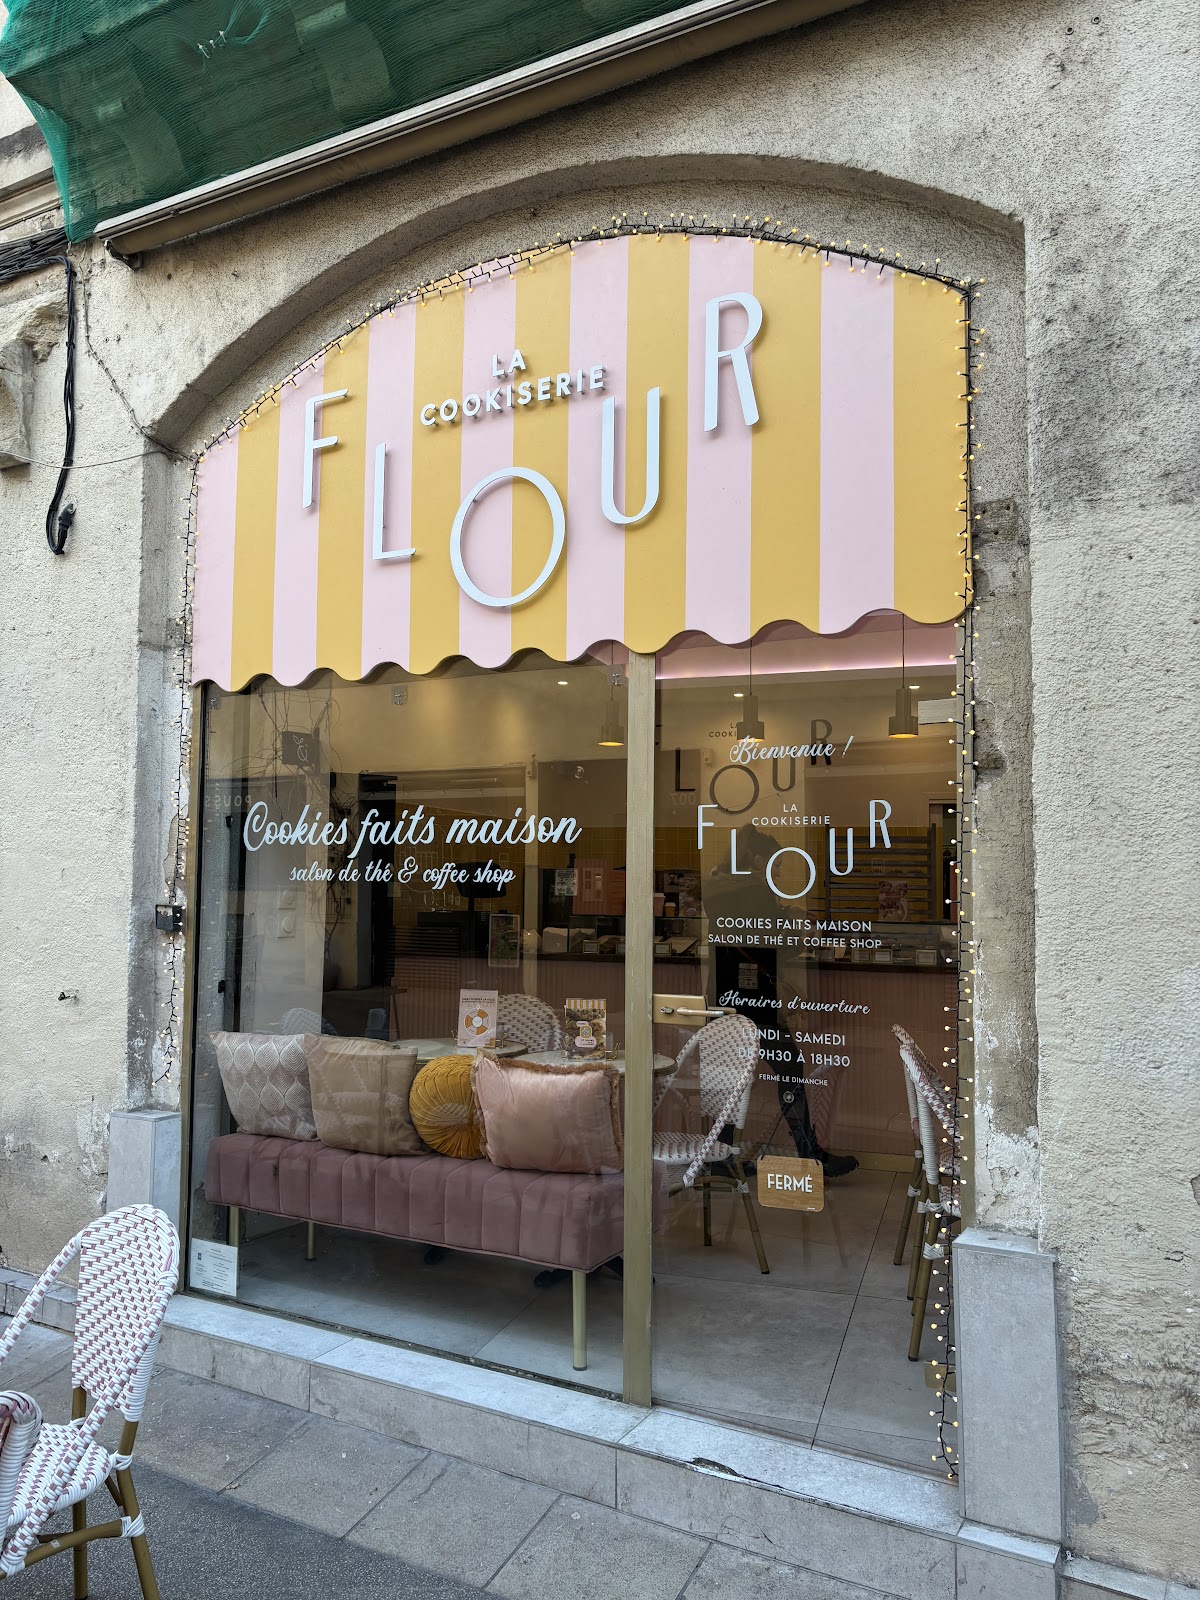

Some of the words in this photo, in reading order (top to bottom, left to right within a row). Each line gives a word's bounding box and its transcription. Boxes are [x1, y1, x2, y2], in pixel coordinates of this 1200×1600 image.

[491, 348, 527, 379] LA
[419, 363, 608, 428] COOKISERIE
[302, 291, 764, 608] FLOUR
[728, 734, 837, 765] Bienvenue
[783, 803, 798, 813] LA
[243, 800, 349, 853] Cookies
[347, 804, 436, 859] faits
[445, 807, 583, 845] maison
[751, 815, 831, 826] COOKISERIE
[697, 799, 892, 899] FLOUR
[288, 860, 336, 882] salon
[338, 859, 362, 882] de
[364, 860, 394, 883] thé
[397, 856, 419, 884] &
[422, 862, 470, 890] coffee
[472, 859, 516, 892] shop
[716, 917, 772, 930] COOKIES
[776, 918, 812, 931] FAITS
[816, 920, 872, 933] MAISON
[708, 933, 743, 945] SALON
[746, 935, 760, 945] DE
[763, 933, 783, 946] THÉ
[787, 936, 799, 946] ET
[803, 936, 846, 948] COFFEE
[850, 938, 882, 949] SHOP
[719, 990, 783, 1009] Horaires
[787, 995, 871, 1015] d'ouverture
[742, 1028, 780, 1041] LUNDI
[795, 1031, 846, 1046] SAMEDI
[738, 1047, 756, 1060] DE
[758, 1048, 792, 1062] 9H30
[796, 1049, 806, 1064] À
[810, 1053, 851, 1068] 18H30
[759, 1073, 781, 1082] FERMÉ
[782, 1075, 790, 1083] LE
[791, 1076, 828, 1086] DIMANCHE
[767, 1173, 813, 1193] FERMÉ
